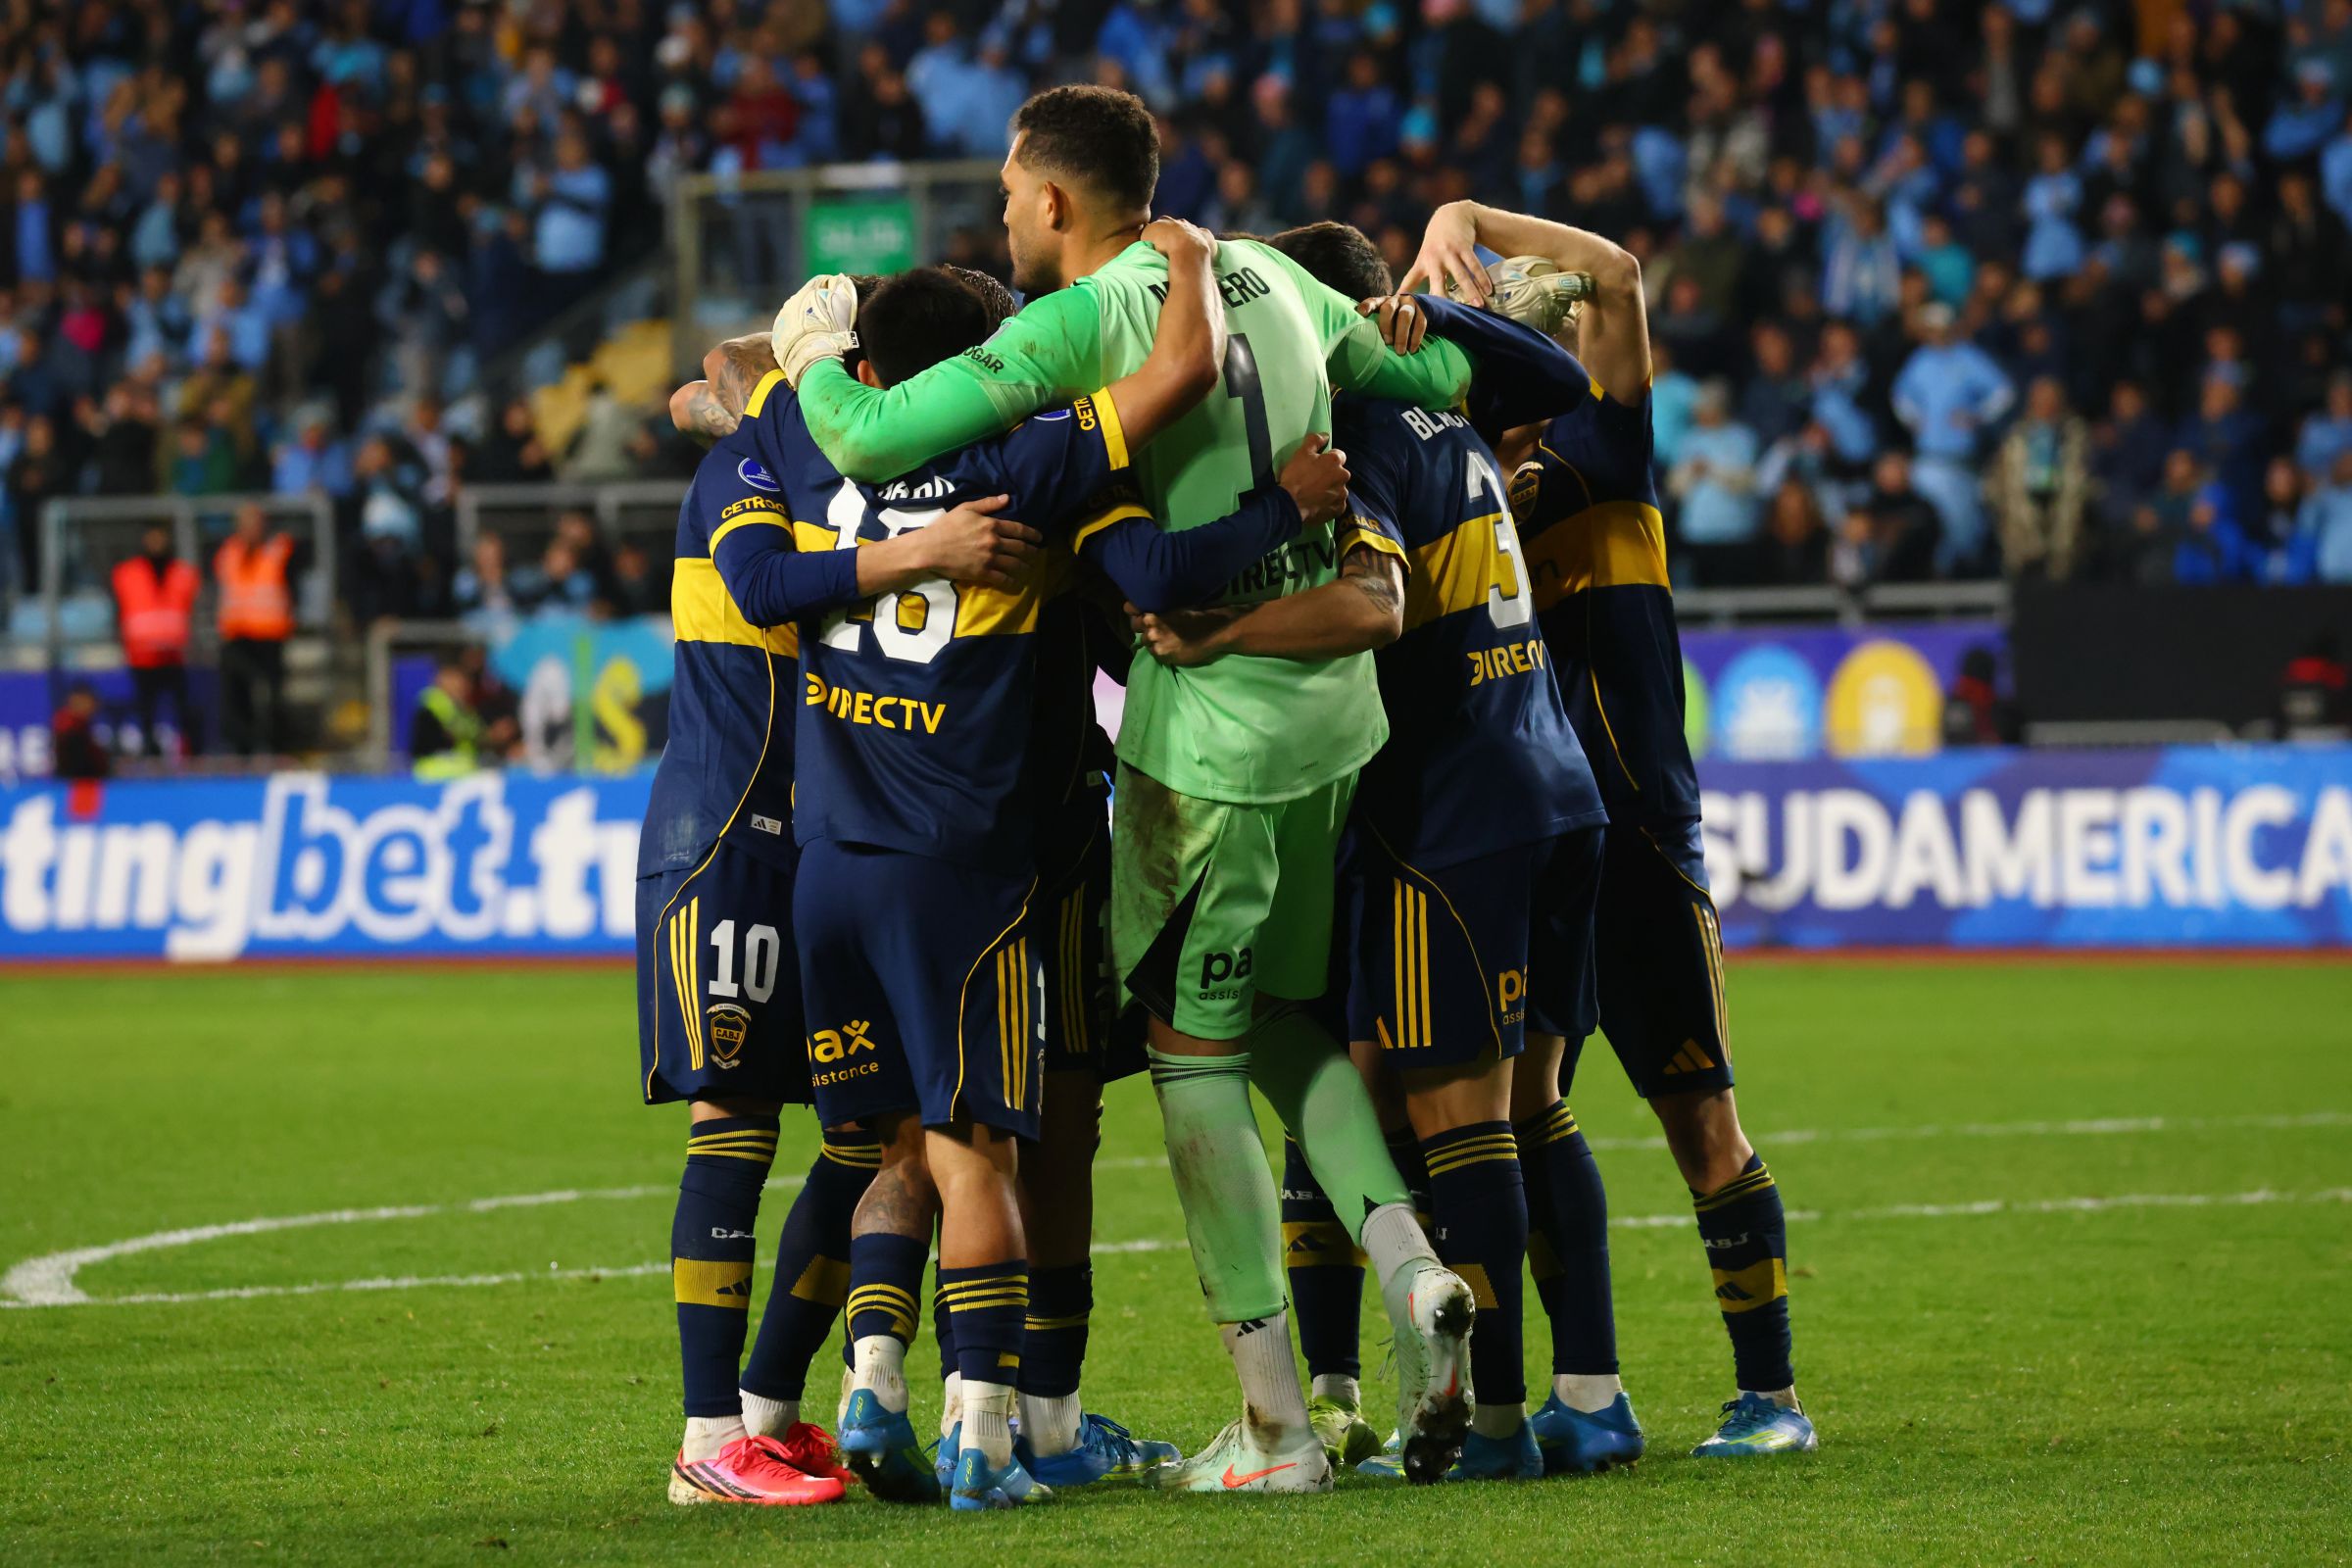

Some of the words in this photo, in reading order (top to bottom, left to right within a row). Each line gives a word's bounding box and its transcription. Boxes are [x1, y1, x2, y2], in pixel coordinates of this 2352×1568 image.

[1223, 332, 1276, 508] 1
[1466, 450, 1533, 630] 3
[806, 672, 946, 735] DIRECTV
[1699, 786, 2352, 912] SUDAMERICA
[709, 918, 781, 1004] 10
[715, 1028, 741, 1042] CABJ
[807, 1019, 877, 1064] ax
